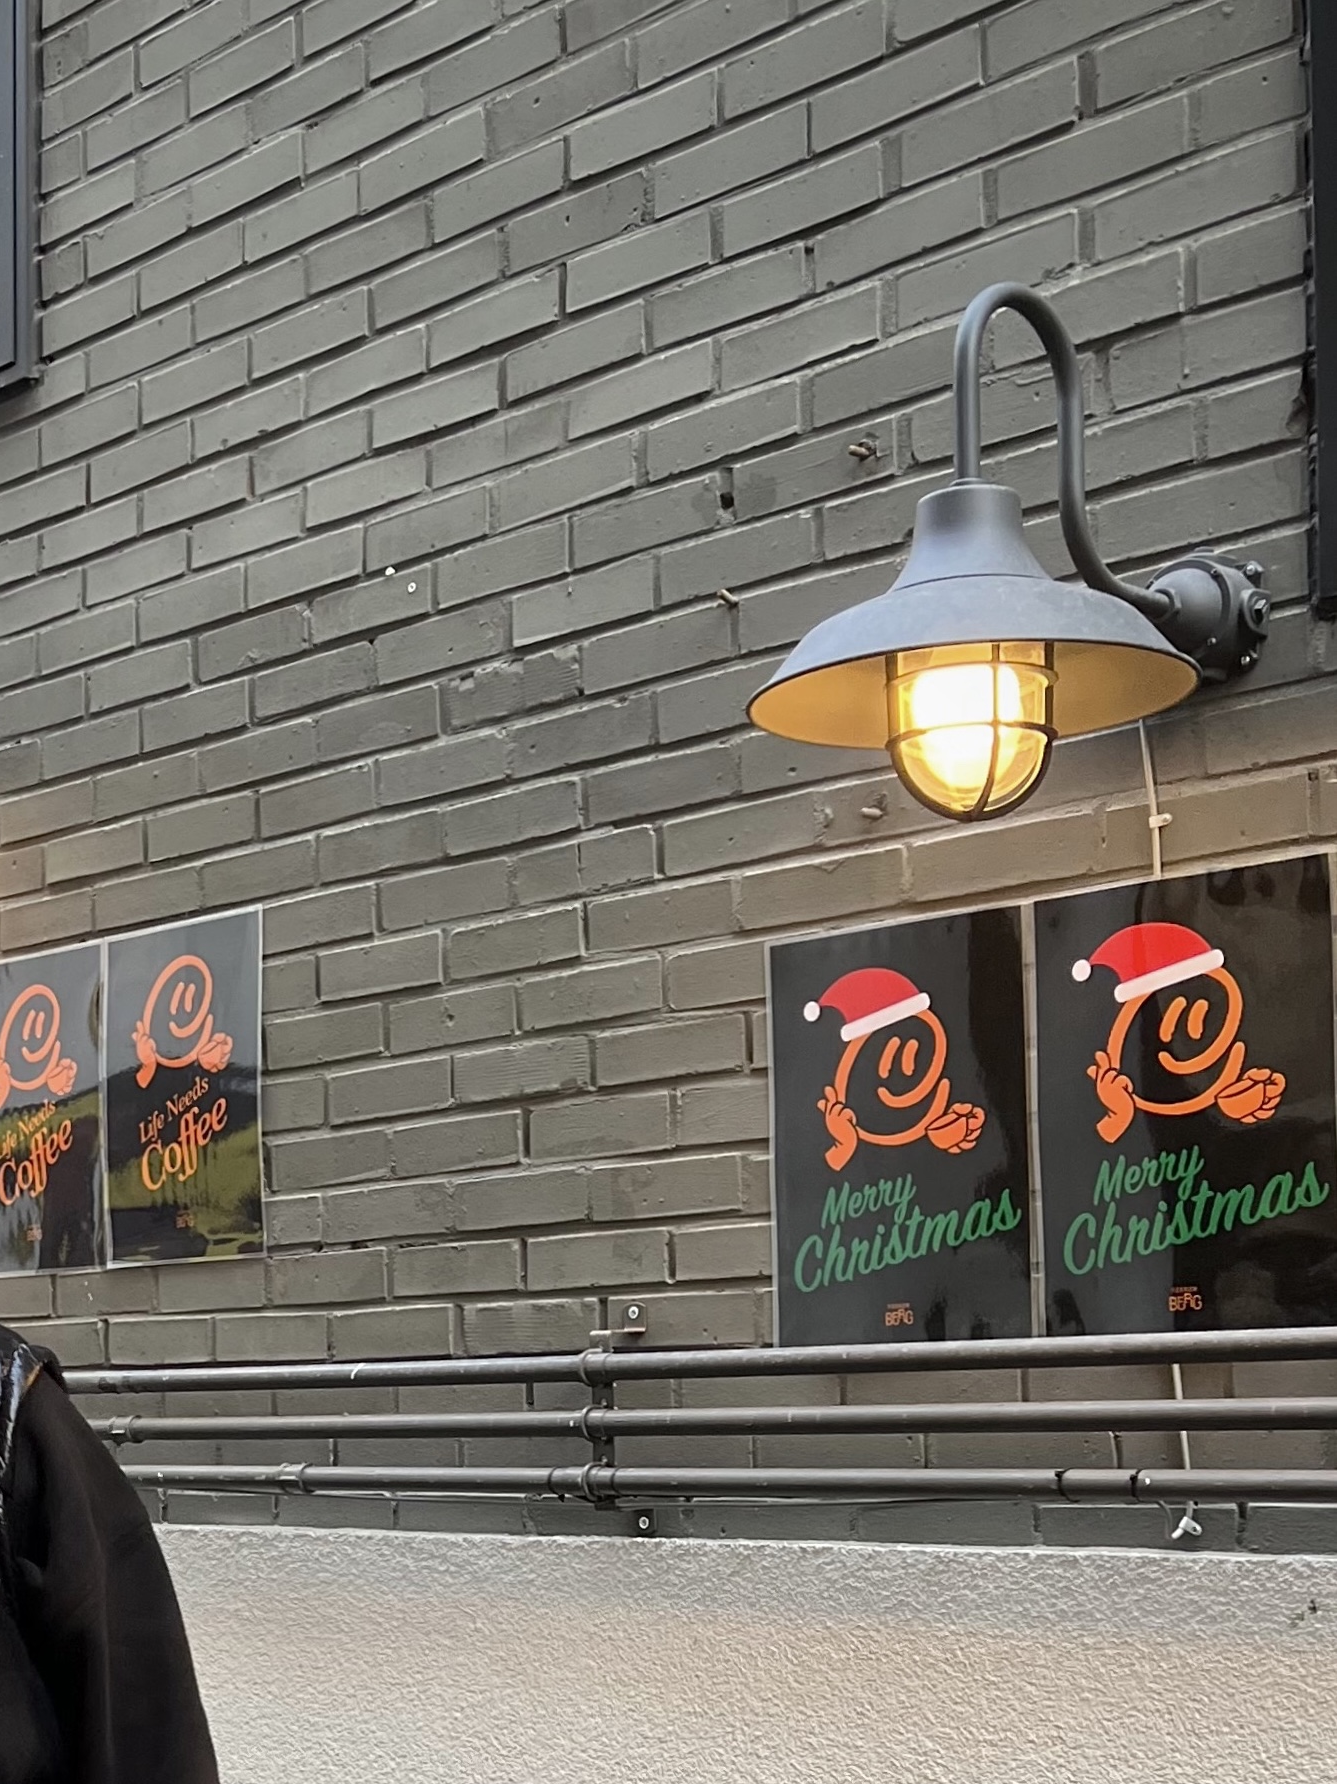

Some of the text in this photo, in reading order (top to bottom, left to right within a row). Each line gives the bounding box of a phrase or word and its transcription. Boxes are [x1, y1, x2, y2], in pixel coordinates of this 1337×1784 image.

[18, 1099, 56, 1141] Needs
[139, 1076, 209, 1144] Life Needs
[142, 1097, 227, 1191] Coffee
[1093, 1145, 1204, 1206] Merry
[821, 1173, 916, 1230] Merry
[1063, 1161, 1330, 1275] Christmas
[794, 1188, 1022, 1293] Christmas
[1168, 1292, 1203, 1311] BERG
